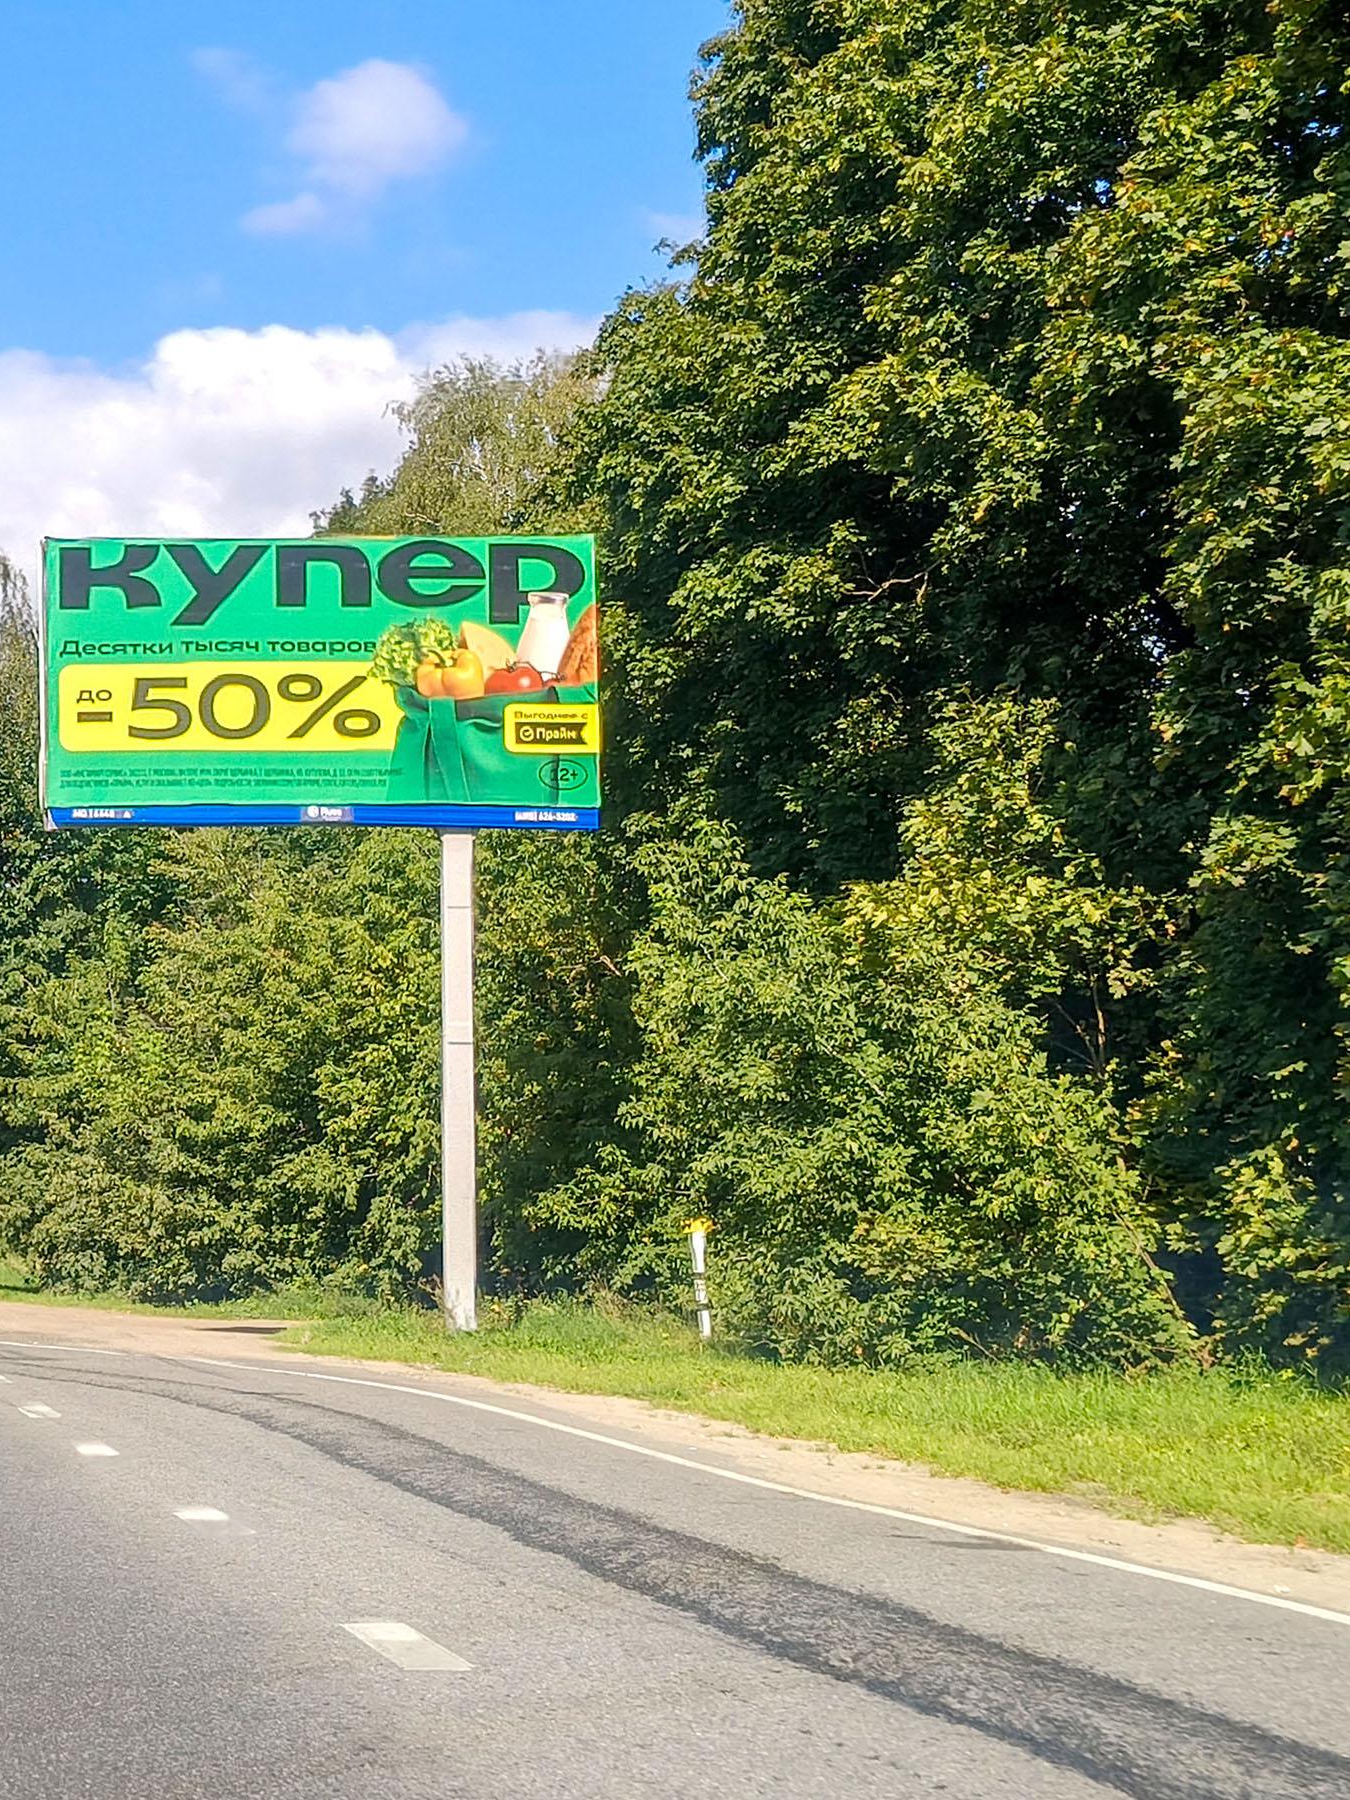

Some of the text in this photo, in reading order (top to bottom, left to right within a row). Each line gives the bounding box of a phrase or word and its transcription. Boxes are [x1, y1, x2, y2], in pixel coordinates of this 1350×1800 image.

[59, 639, 378, 657] Десятки тысяч товаров
[76, 690, 113, 704] до
[77, 673, 381, 740] -50%
[536, 727, 577, 741] Прайм
